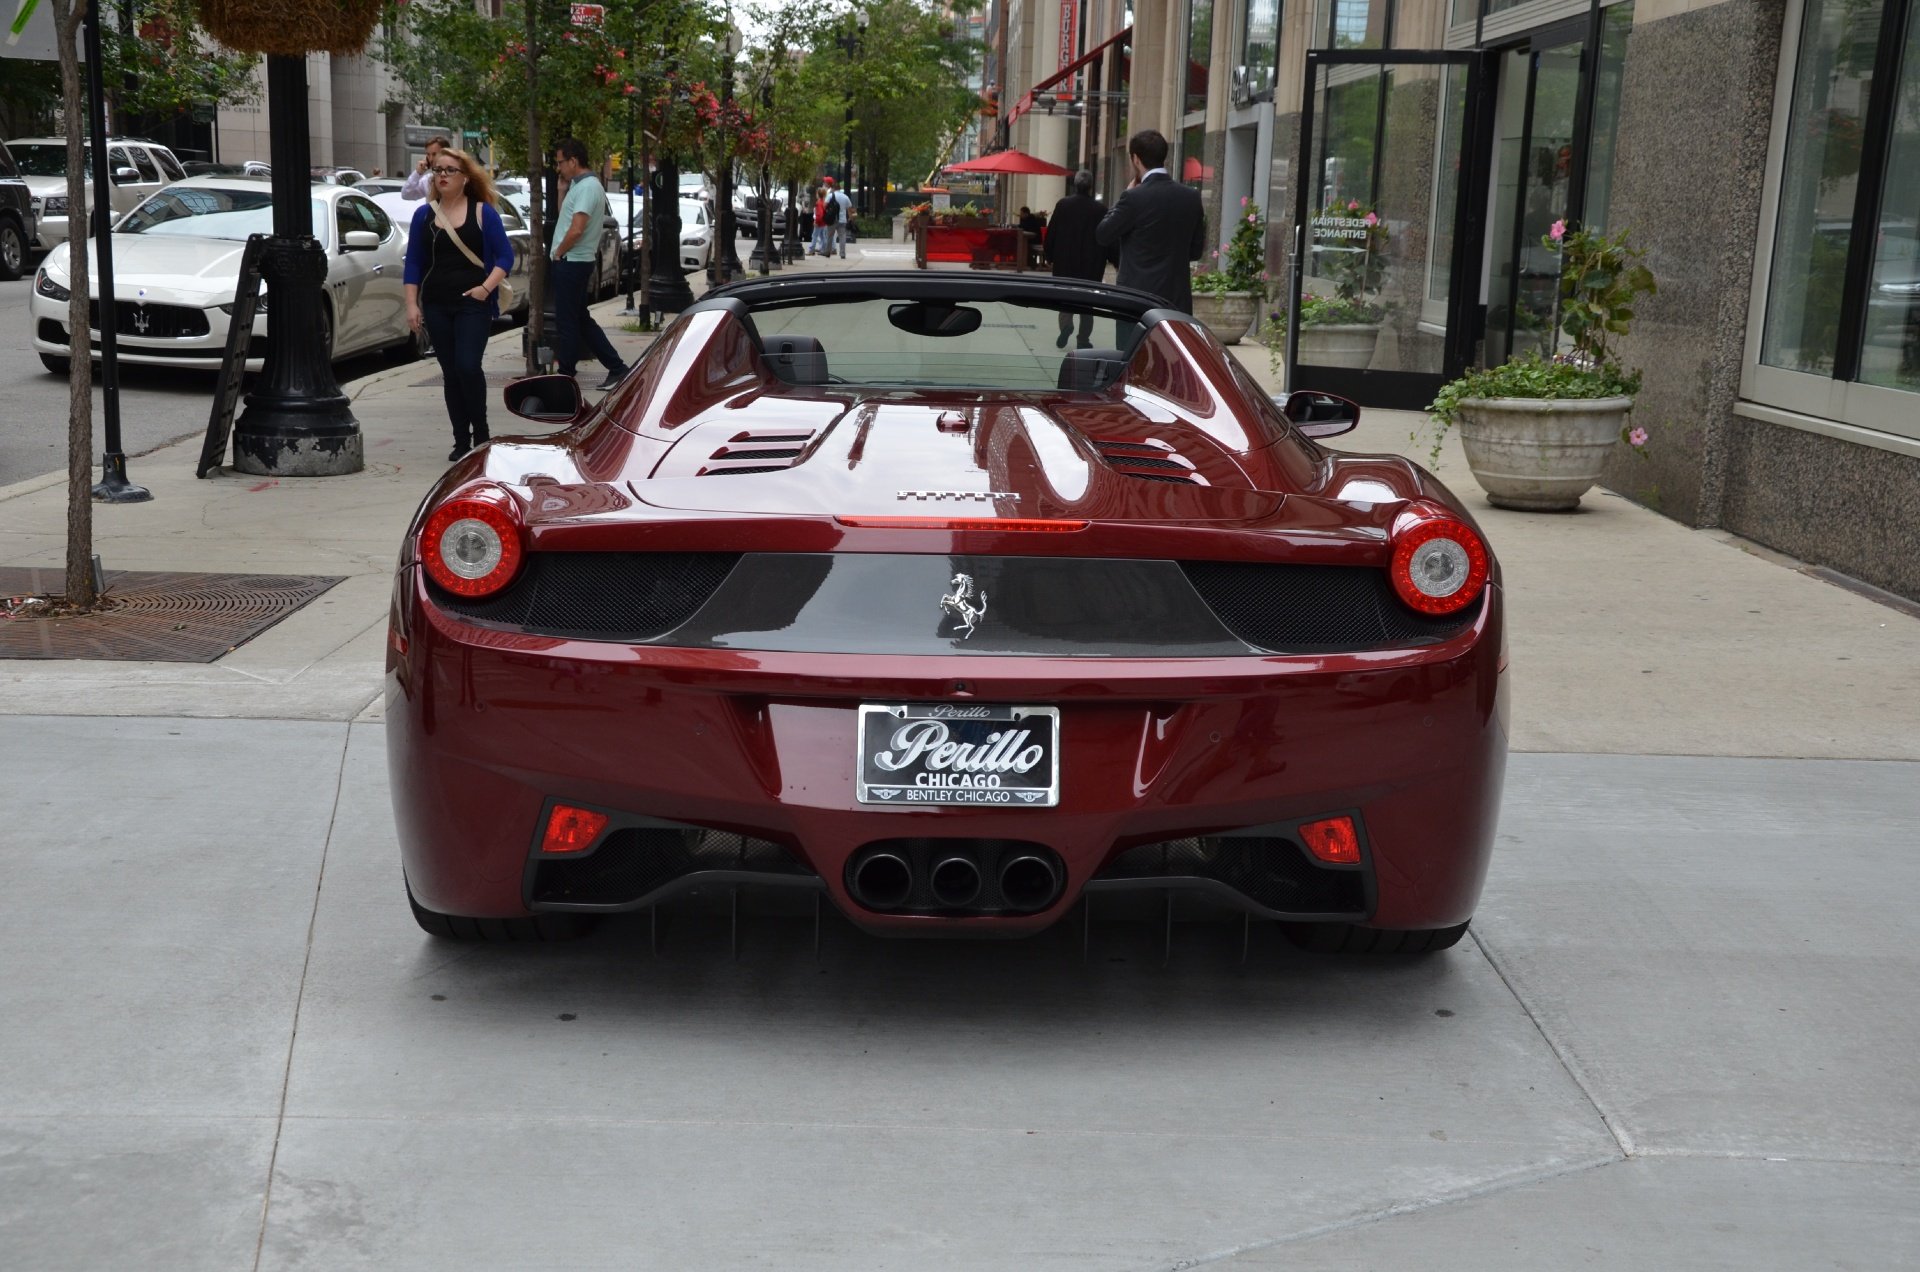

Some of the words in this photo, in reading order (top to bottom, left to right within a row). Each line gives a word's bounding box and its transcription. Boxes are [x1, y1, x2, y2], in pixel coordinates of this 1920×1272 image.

[928, 704, 992, 719] Perillo
[874, 719, 1044, 773] Perillo
[915, 772, 1001, 788] CHICAGO
[906, 789, 953, 801] BENTLEY
[955, 790, 1010, 803] CHICAGO
